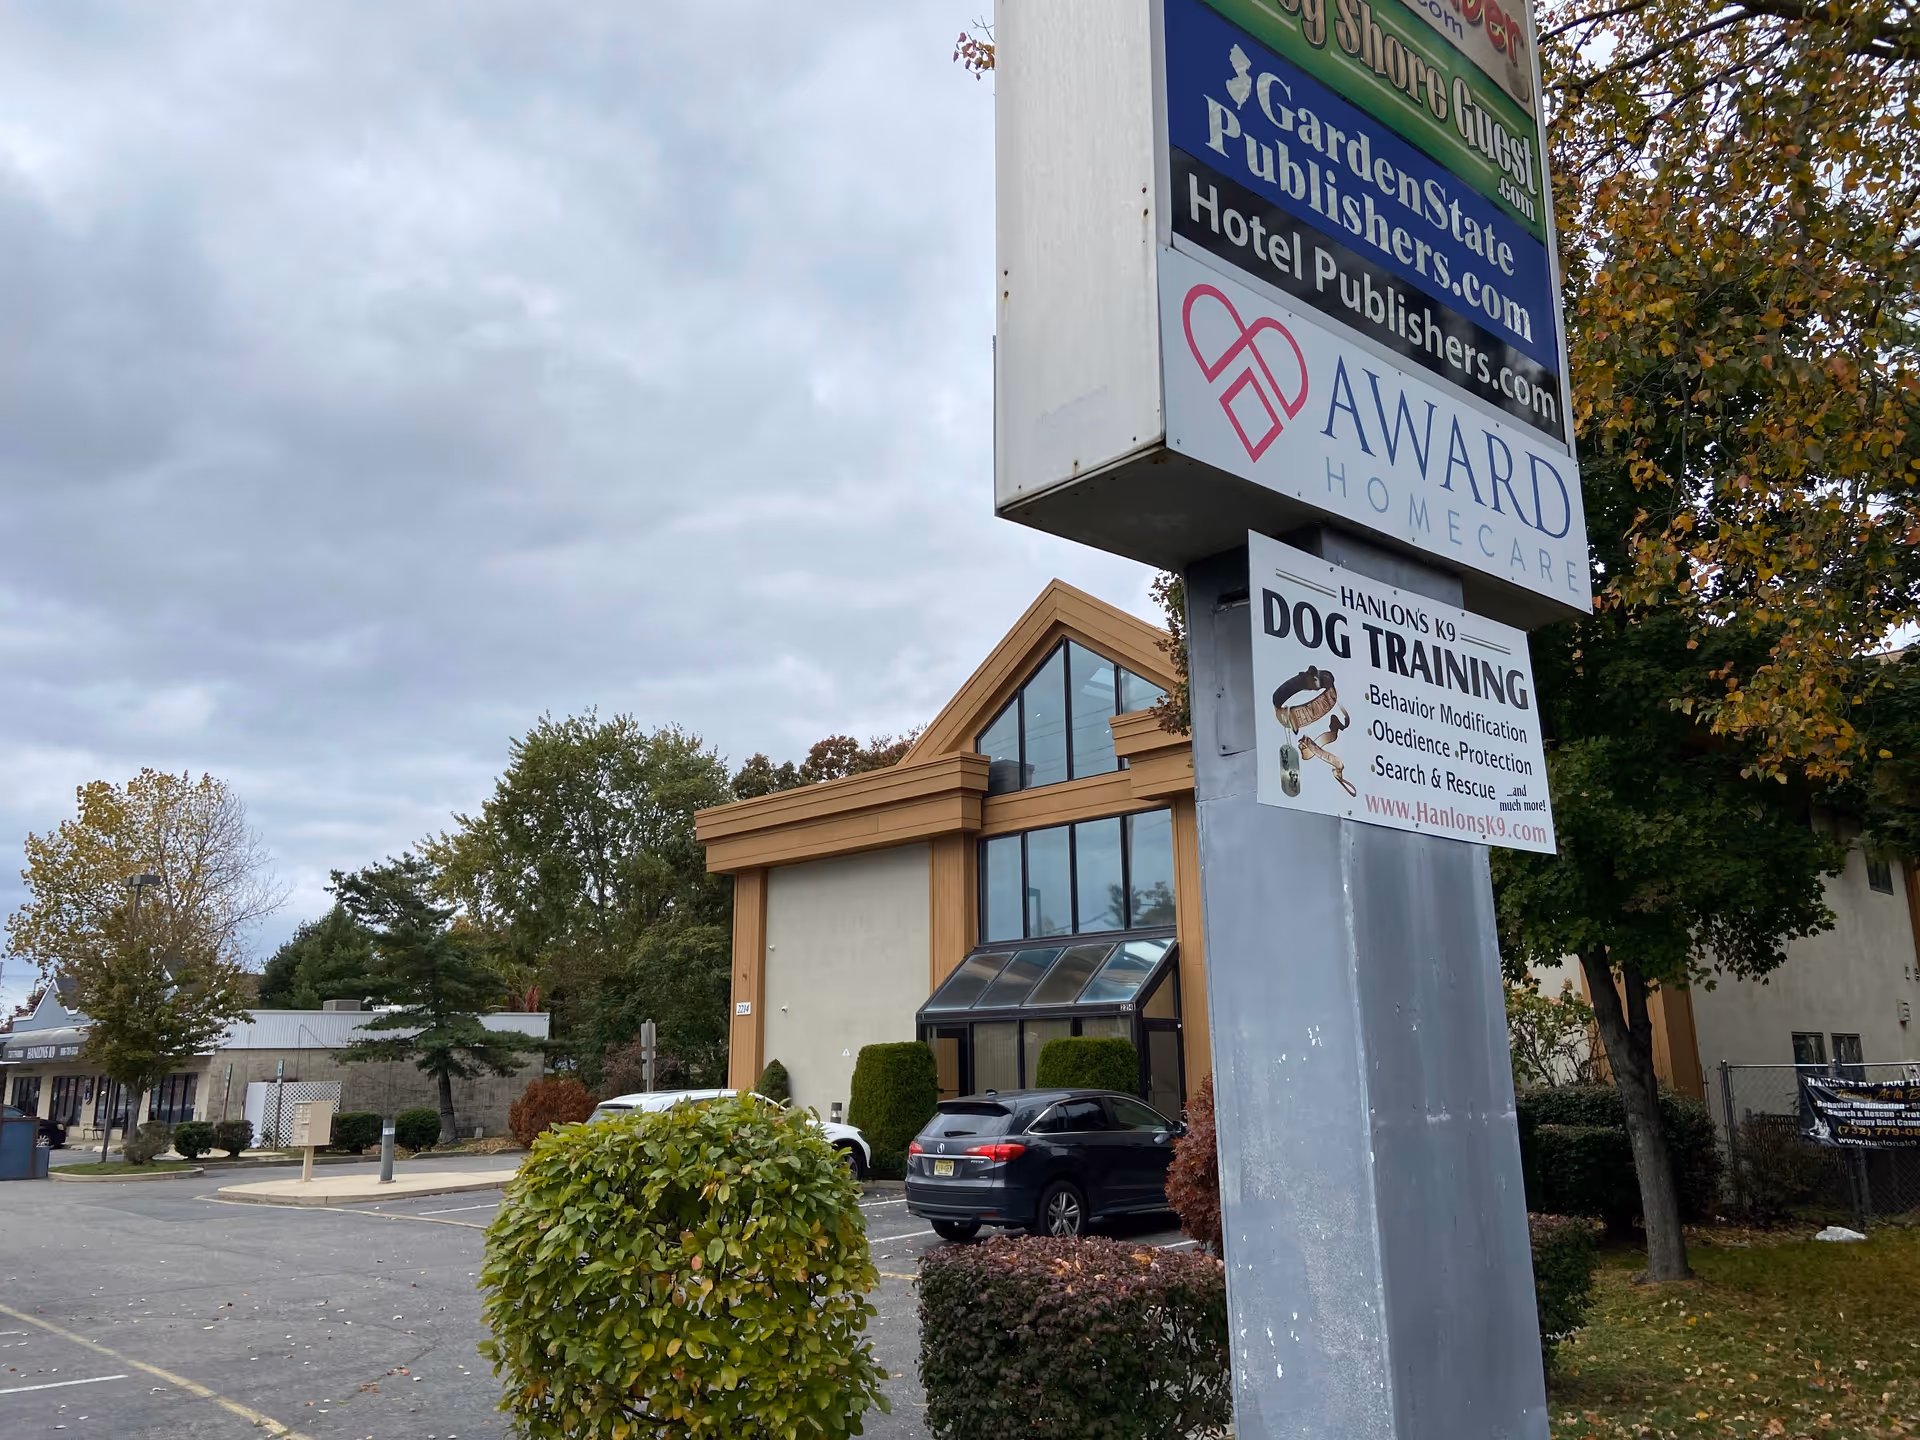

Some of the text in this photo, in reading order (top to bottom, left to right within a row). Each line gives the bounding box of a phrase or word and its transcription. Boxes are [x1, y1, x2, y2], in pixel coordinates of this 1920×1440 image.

[1335, 0, 1449, 122] Shore
[1452, 75, 1537, 195] Guest
[1203, 94, 1533, 344] Publishers.com
[1256, 72, 1515, 276] GardenState
[1497, 177, 1535, 221] .com
[1188, 172, 1557, 423] Hotel Publishers.com
[1319, 354, 1571, 538] AWARD
[1325, 456, 1580, 593] HOMECARE
[1262, 587, 1529, 710] DOG TRAINING
[1340, 585, 1456, 643] HANLON'S K9
[1369, 683, 1435, 720] Behavior
[1440, 703, 1528, 743] Modification
[1372, 719, 1533, 776] Obedience Protection
[1365, 793, 1547, 844] www.HanlonsK9.com
[1375, 754, 1496, 801] Search & Rescue
[1499, 798, 1546, 812] much more!
